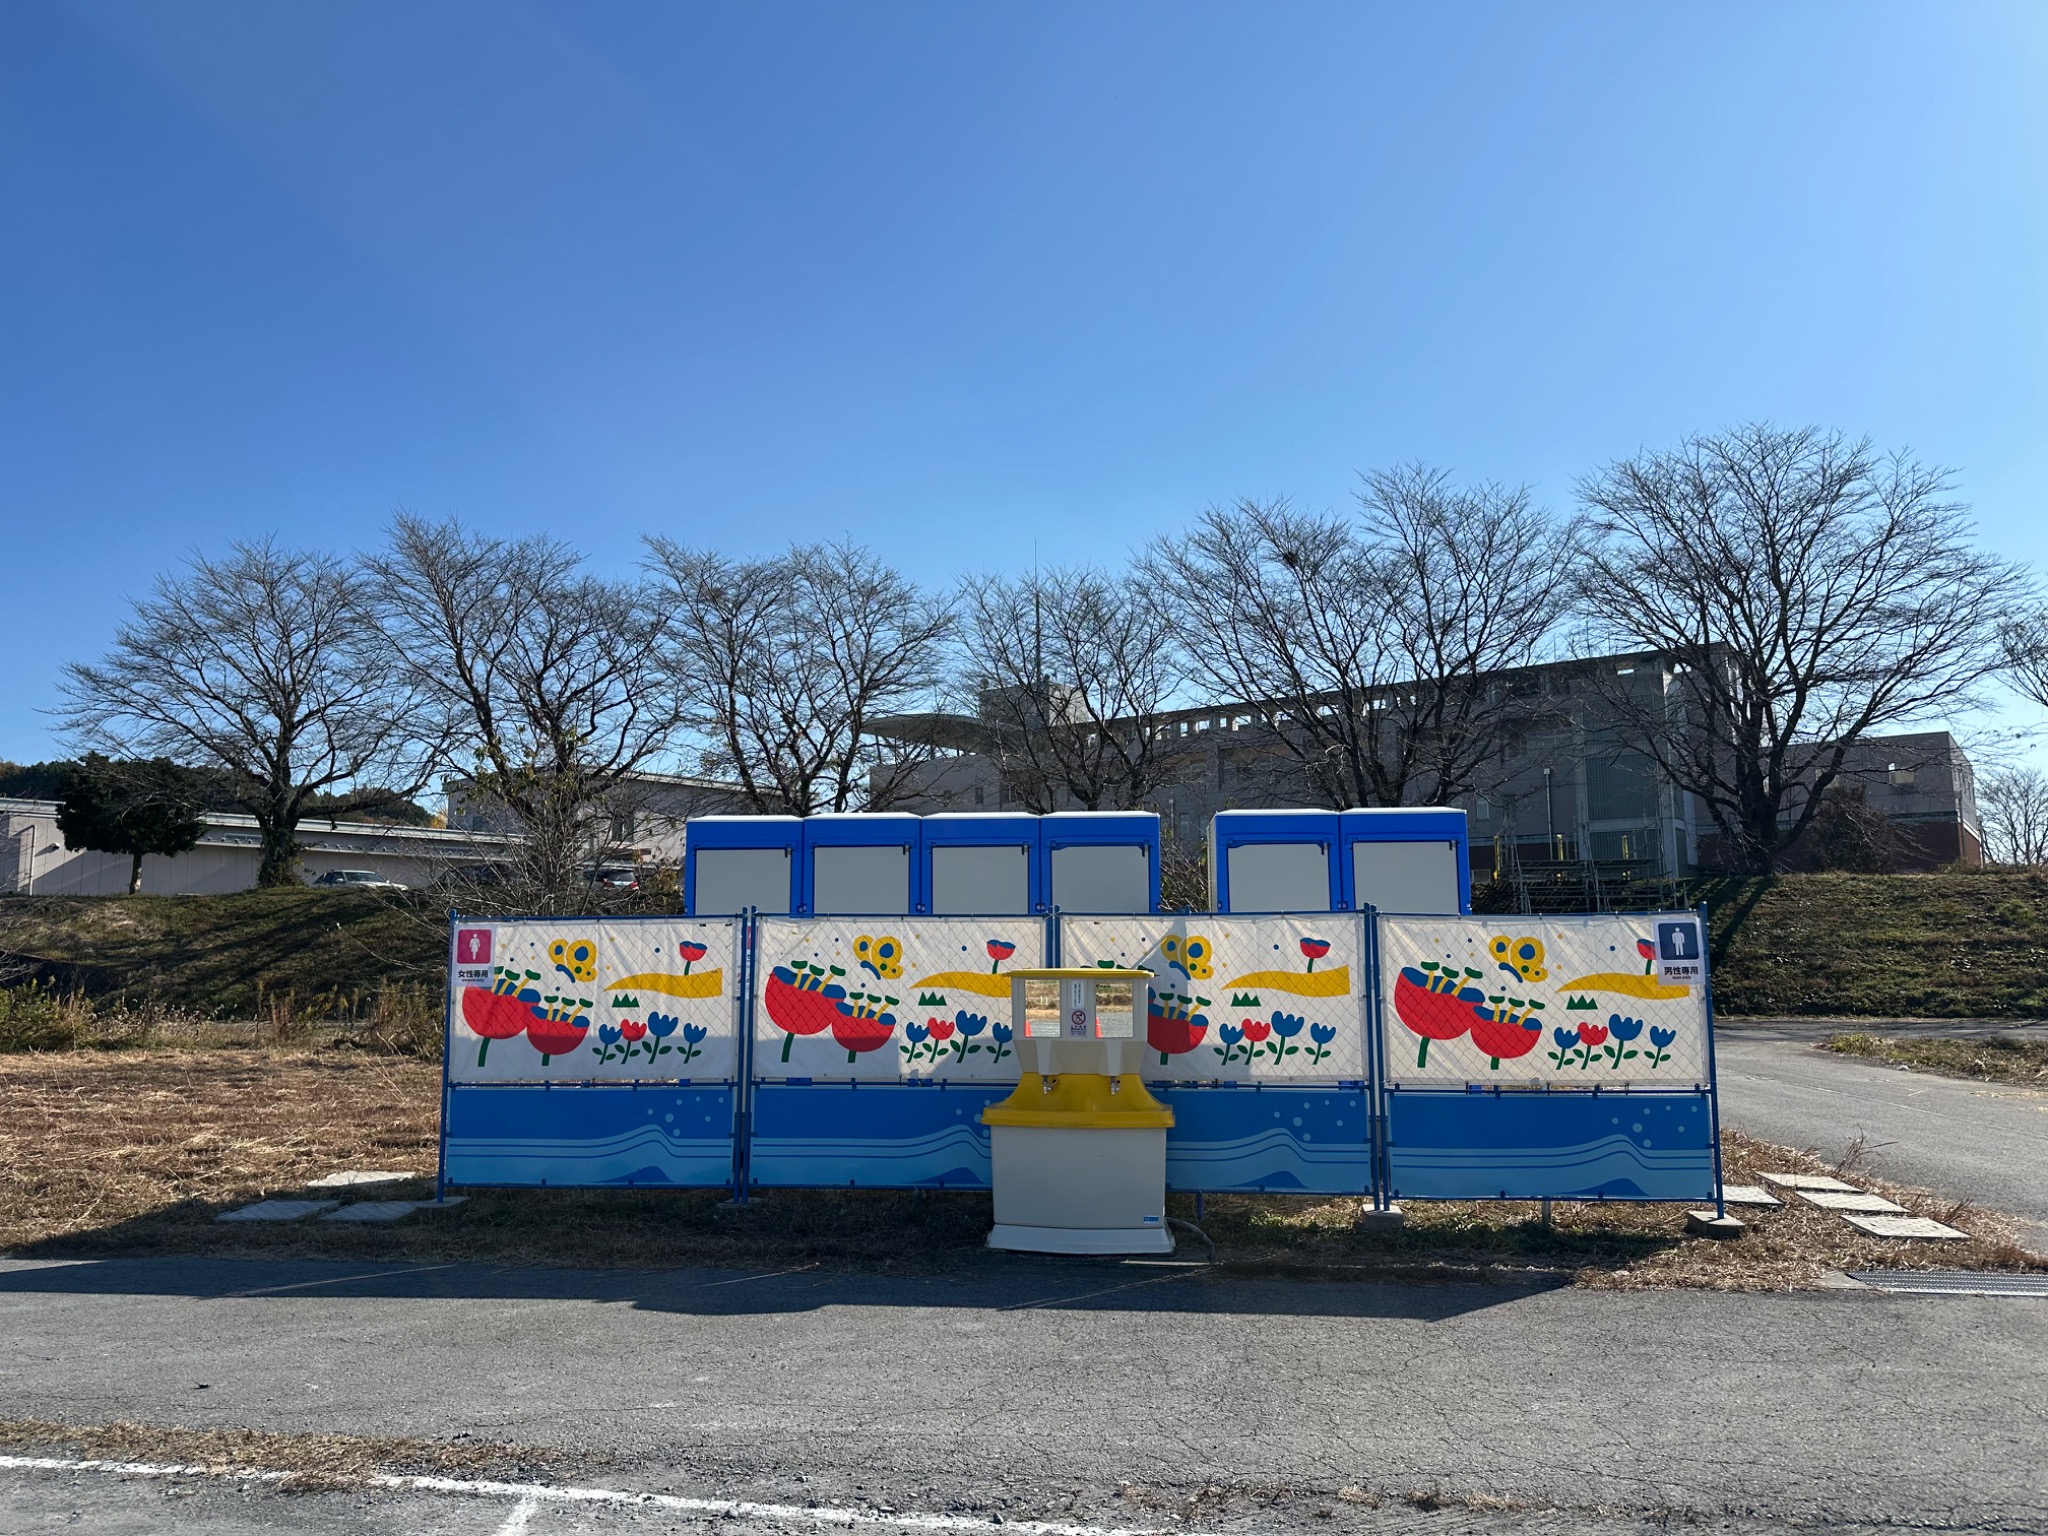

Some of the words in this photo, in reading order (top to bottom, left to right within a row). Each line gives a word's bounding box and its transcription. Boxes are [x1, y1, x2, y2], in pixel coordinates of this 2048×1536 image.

[458, 969, 489, 978] 女性専用
[1664, 966, 1698, 975] 男性専用
